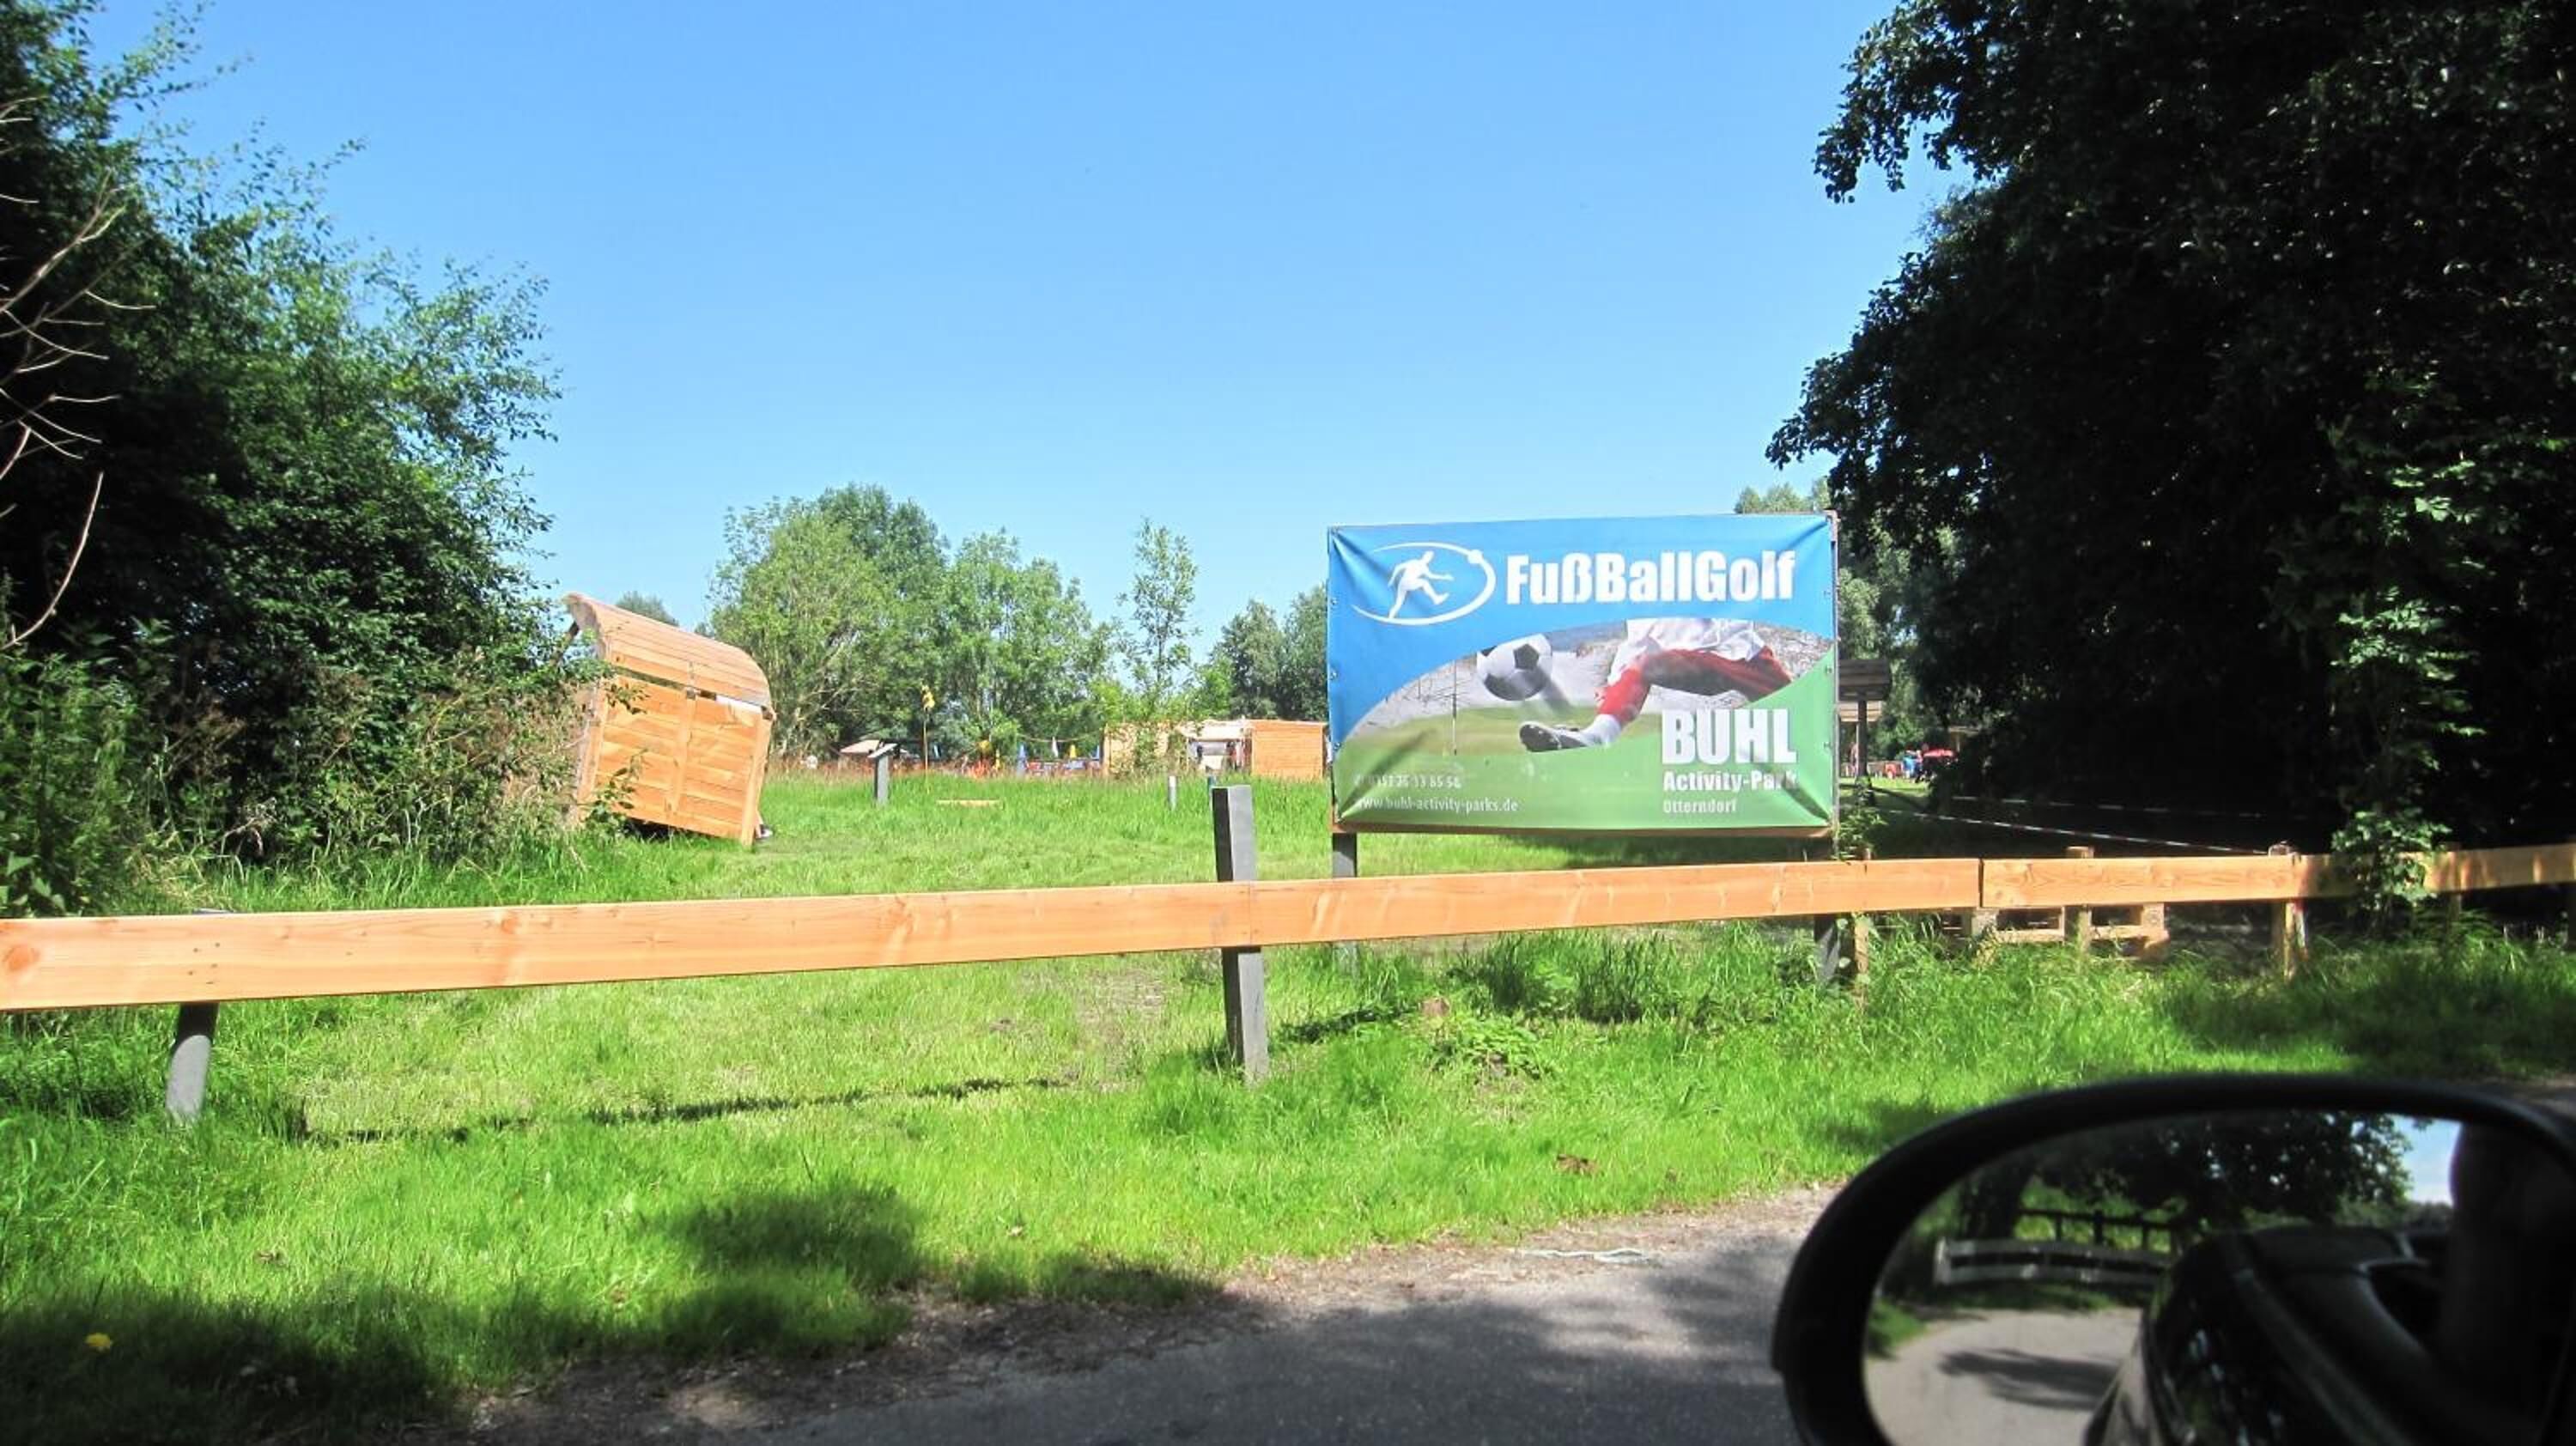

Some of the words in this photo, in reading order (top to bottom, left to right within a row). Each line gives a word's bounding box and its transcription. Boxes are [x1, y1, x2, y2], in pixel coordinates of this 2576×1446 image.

[1507, 550, 1795, 604] FußBallGolf
[1662, 708, 1797, 764] BUHL
[1663, 770, 1797, 793] Activity-Park
[1663, 799, 1737, 813] Otterndorf
